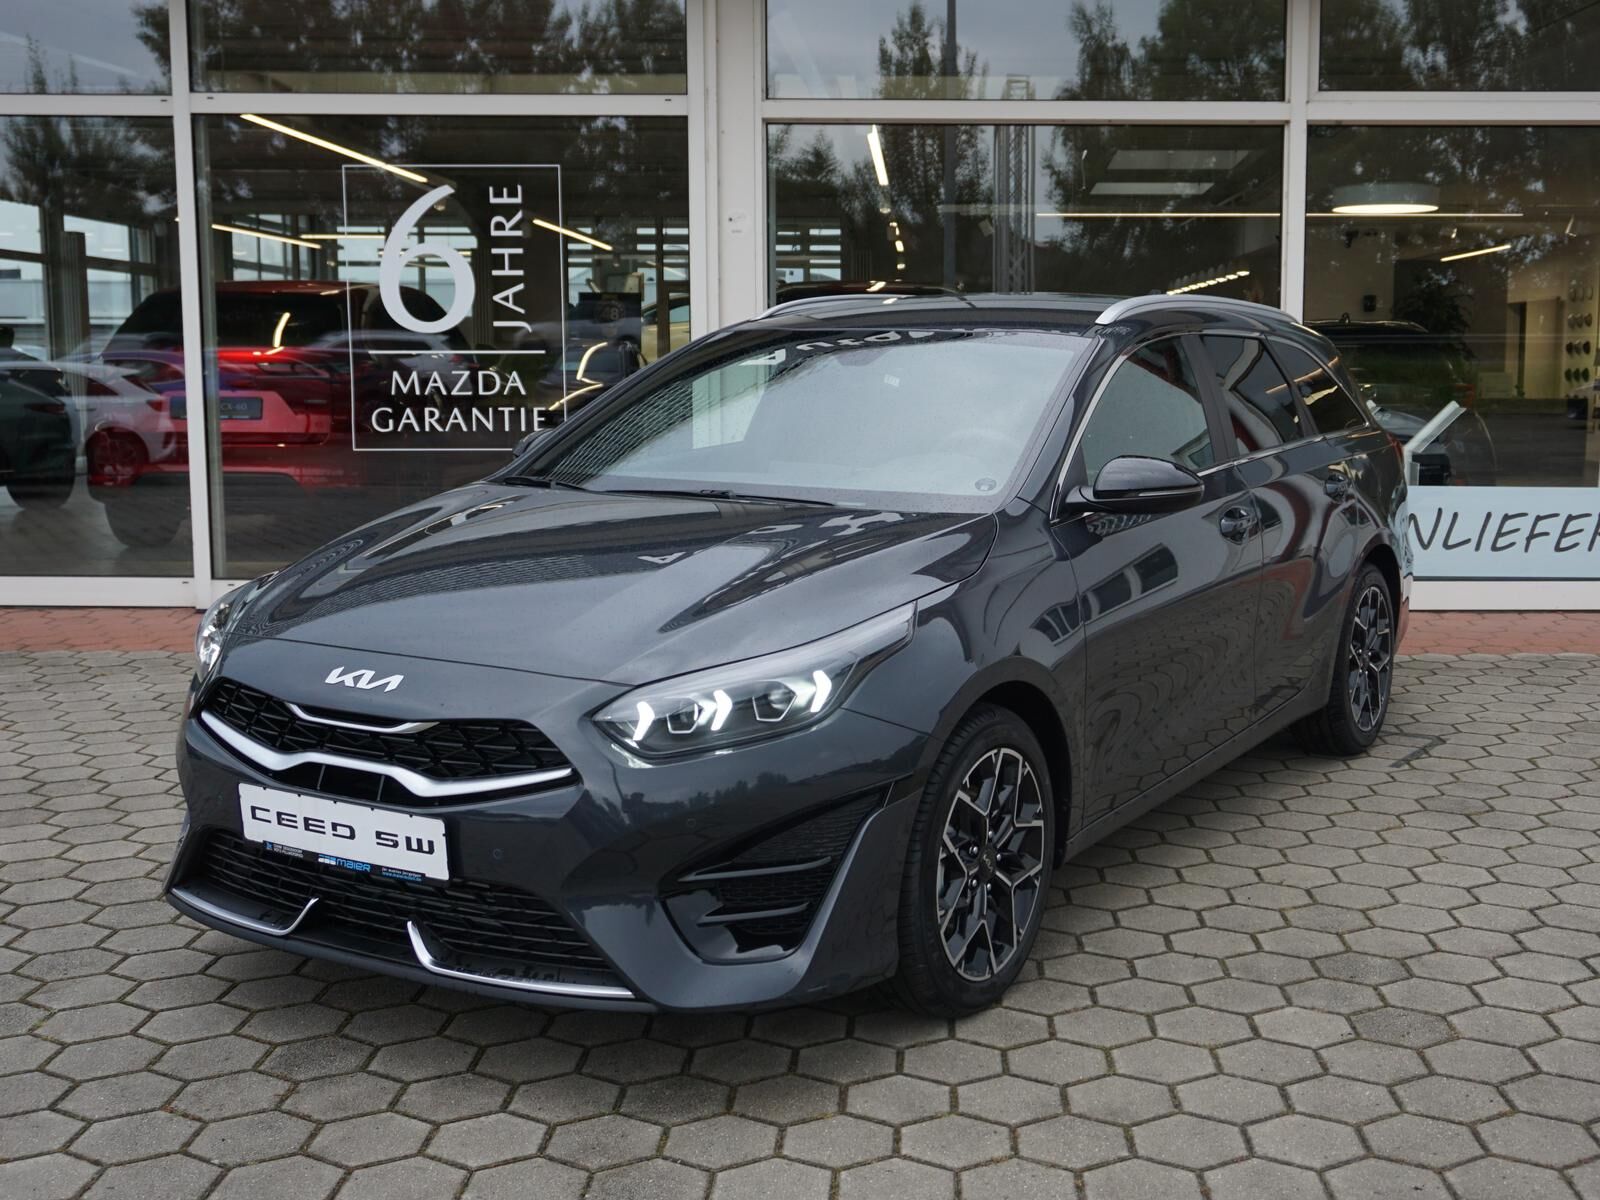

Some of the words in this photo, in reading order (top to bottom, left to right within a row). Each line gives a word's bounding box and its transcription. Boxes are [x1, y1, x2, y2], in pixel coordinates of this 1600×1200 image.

[379, 184, 476, 334] 6
[489, 184, 532, 333] JAHRE
[391, 370, 526, 396] MAZDA
[371, 407, 547, 433] GARANTIE
[324, 666, 404, 693] KIA
[250, 805, 356, 840] CEED
[375, 830, 435, 855] SW
